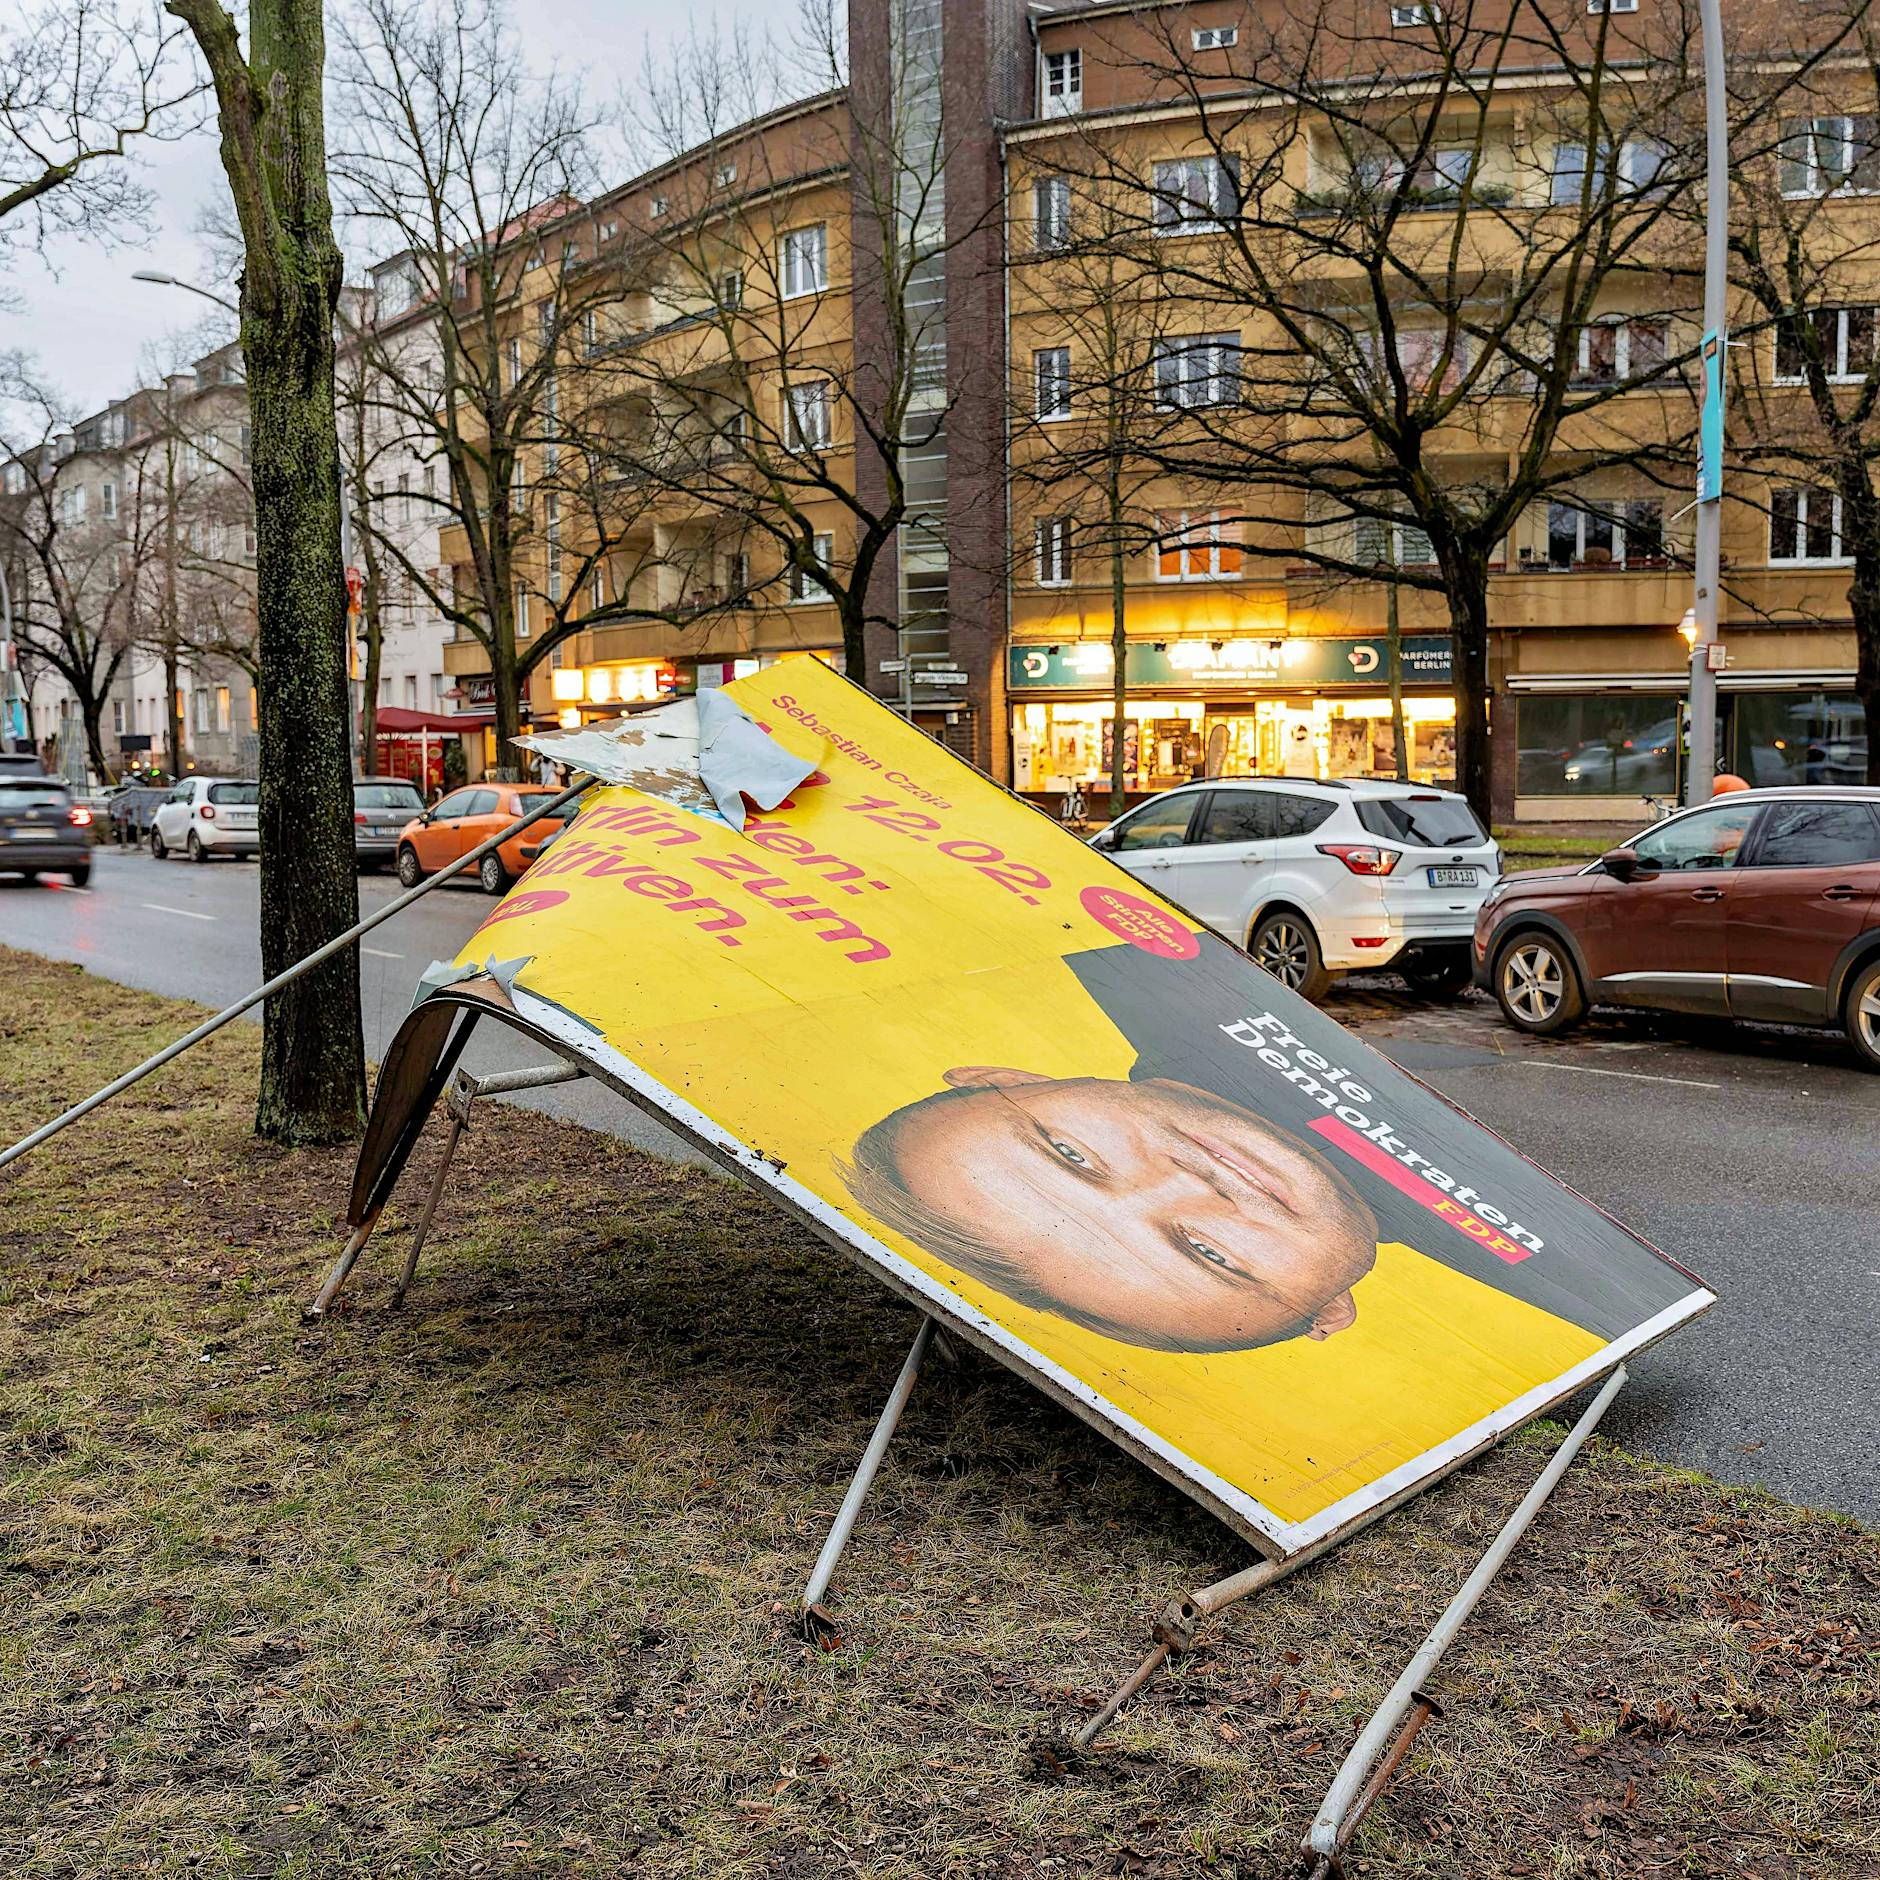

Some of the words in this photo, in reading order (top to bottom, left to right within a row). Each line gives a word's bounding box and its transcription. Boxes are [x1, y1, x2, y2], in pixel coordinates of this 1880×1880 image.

[1413, 660, 1451, 670] BERLIN
[772, 695, 882, 770] Sebastian
[884, 771, 952, 809] Czaja
[1447, 871, 1459, 882] RA
[1460, 871, 1474, 882] 131
[691, 853, 892, 963] zum
[1100, 895, 1185, 953] Stimmen
[1106, 913, 1153, 940] FDP
[1135, 909, 1174, 933] Alle
[1247, 1011, 1373, 1103] Freie
[1218, 1019, 1545, 1253] Demokraten
[1431, 1199, 1520, 1254] FDP
